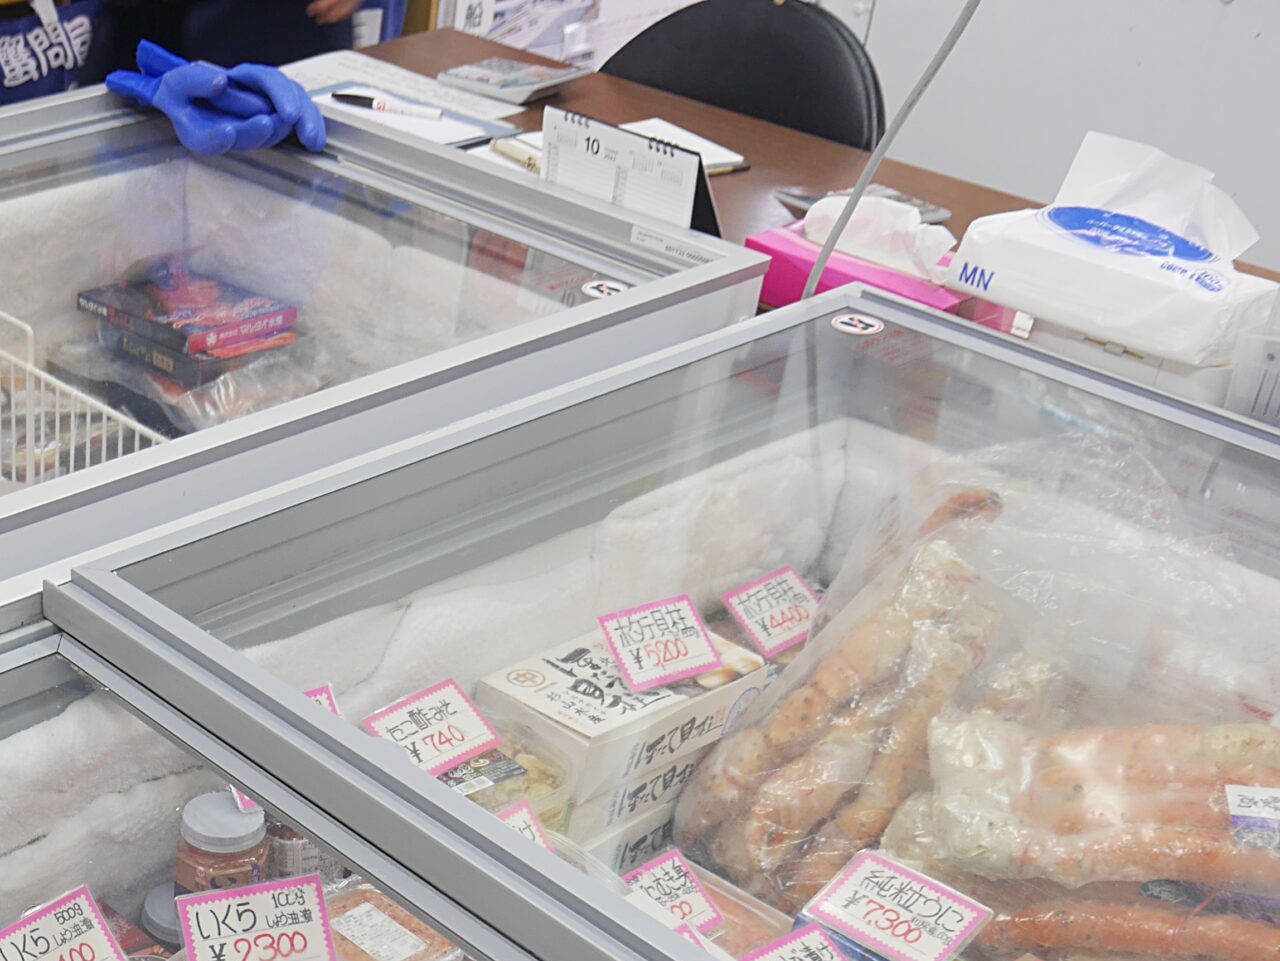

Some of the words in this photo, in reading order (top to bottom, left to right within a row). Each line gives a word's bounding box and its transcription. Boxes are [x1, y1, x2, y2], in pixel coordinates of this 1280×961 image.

[584, 136, 600, 155] 10
[959, 262, 995, 291] MN
[195, 901, 257, 940] いくら
